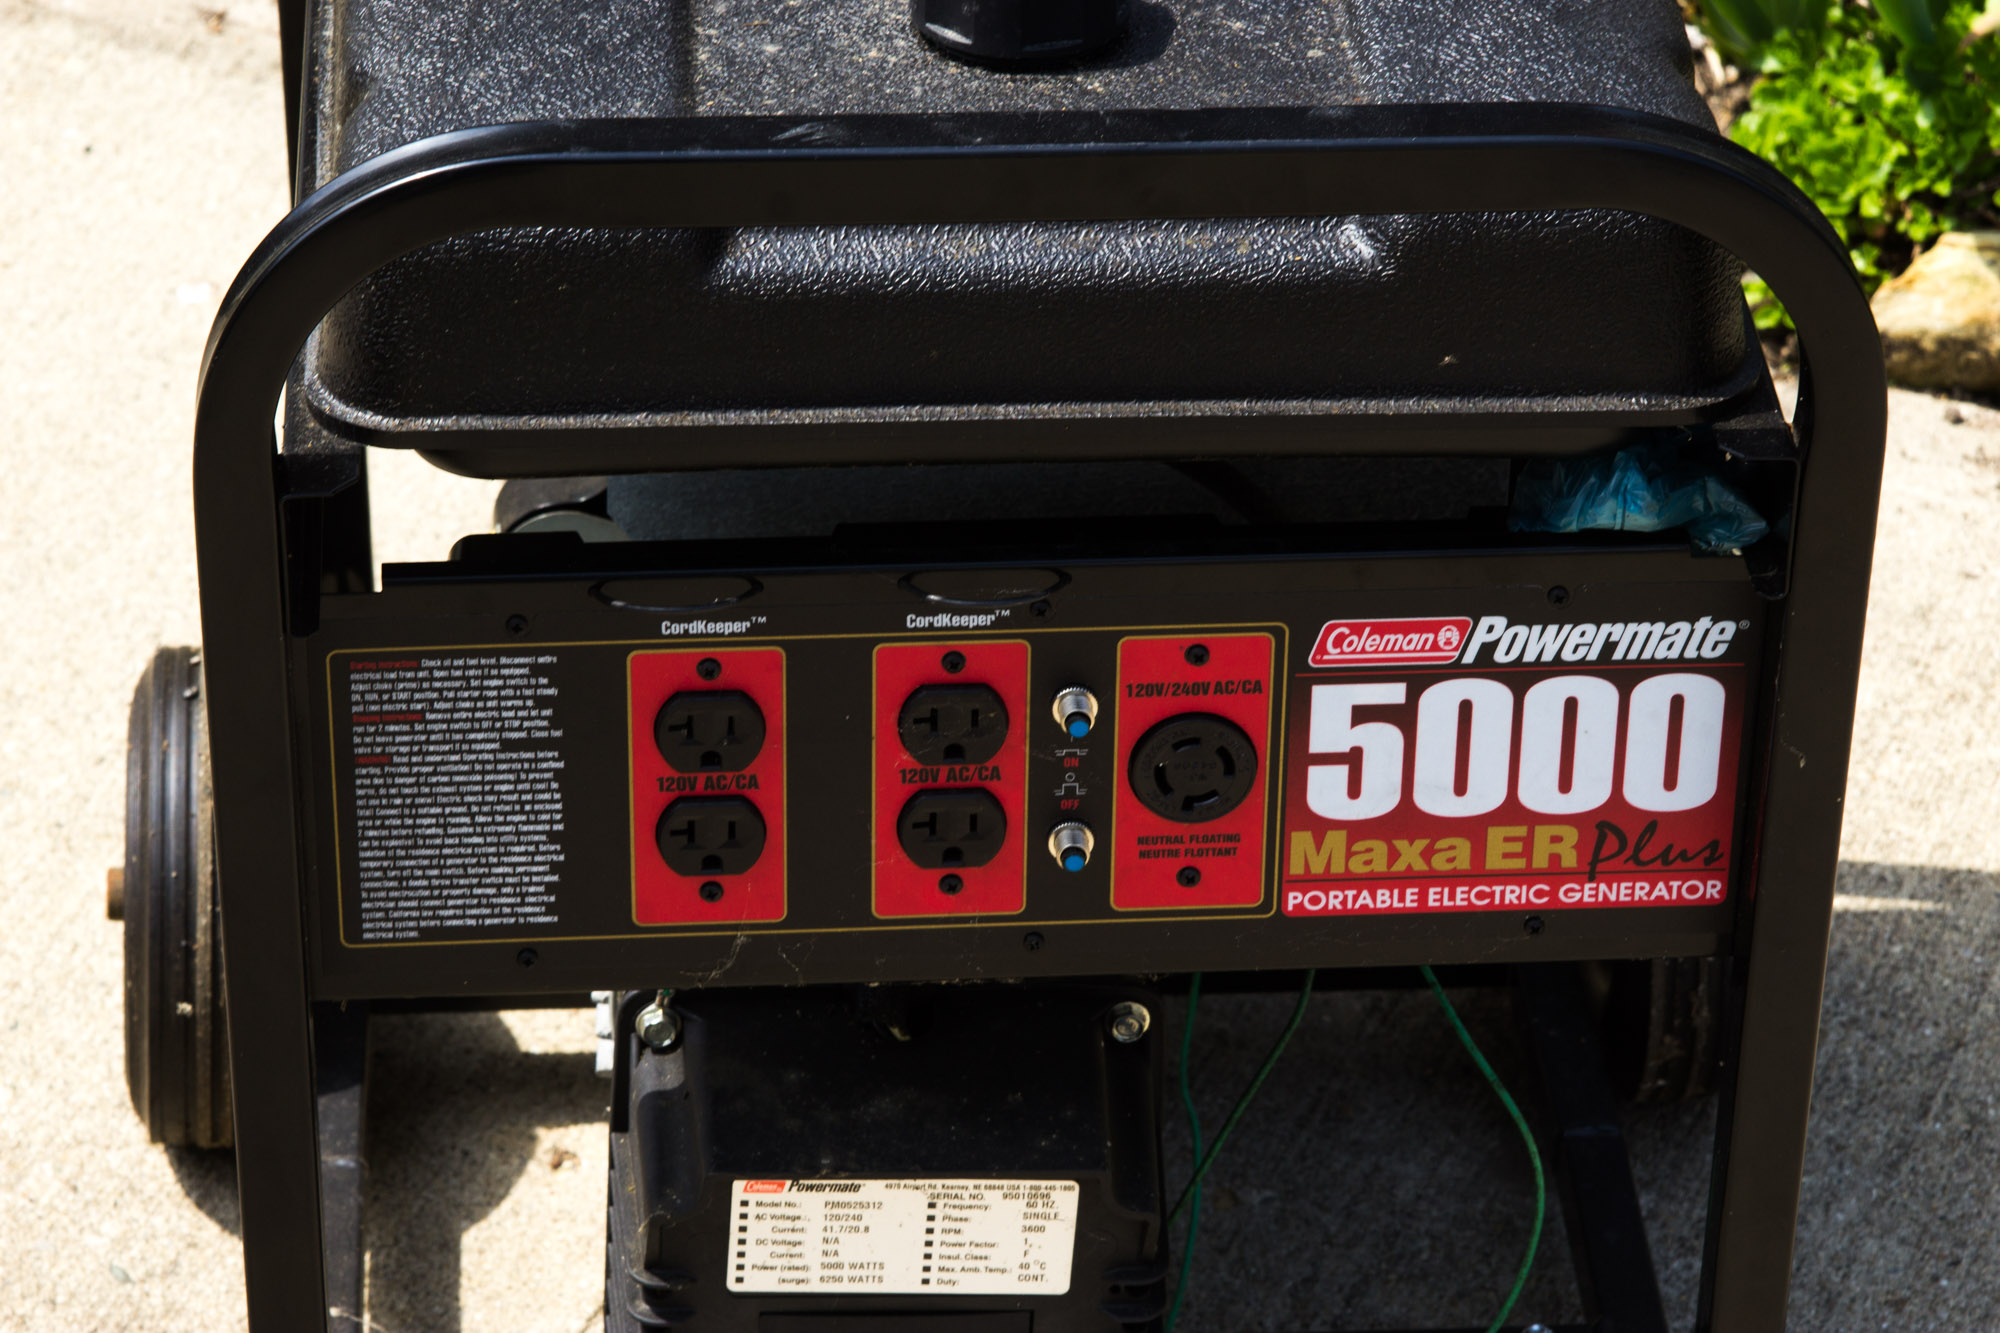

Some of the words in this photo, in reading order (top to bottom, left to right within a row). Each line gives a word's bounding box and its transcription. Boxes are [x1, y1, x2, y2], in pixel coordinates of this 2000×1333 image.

[1325, 626, 1432, 654] Coleman
[1126, 681, 1210, 698] 120V/240V
[1213, 679, 1262, 694] AC/CA
[1306, 673, 1726, 820] 5000
[1064, 758, 1079, 768] ON
[900, 767, 940, 783] 120V
[947, 765, 1001, 782] AC/CA
[657, 776, 697, 793] 120V
[704, 774, 759, 790] AC/CA
[1061, 800, 1079, 809] OFF
[1137, 835, 1184, 845] NEUTRAL
[1189, 833, 1240, 844] FLOATING
[1139, 848, 1180, 859] NEUTRE
[1184, 847, 1238, 858] FLOTTANT
[1289, 829, 1471, 874] Maxa
[1486, 824, 1579, 870] ER
[1588, 820, 1723, 881] Plus
[1288, 888, 1418, 910] PORTABLE
[1427, 884, 1550, 906] ELECTRIC
[1558, 880, 1722, 902] GENERATOR
[903, 1183, 926, 1191] Airport
[930, 1192, 965, 1200] SERIAL
[1003, 1192, 1051, 1200] 95010696
[825, 1201, 883, 1210] PM0525312
[943, 1202, 991, 1211] Frequency:
[1023, 1212, 1059, 1220] SINGLE
[1022, 1225, 1045, 1233] 3600
[771, 1239, 804, 1247] Voltage:
[823, 1237, 839, 1245] N/A
[770, 1251, 804, 1259] Current:
[781, 1264, 811, 1272] (rated):
[821, 1262, 844, 1270] 5000
[849, 1262, 884, 1270] WATTS
[820, 1275, 843, 1283] 6250
[848, 1275, 883, 1283] WATTS
[937, 1278, 959, 1287] Duty:
[1018, 1274, 1048, 1282] CONT.
